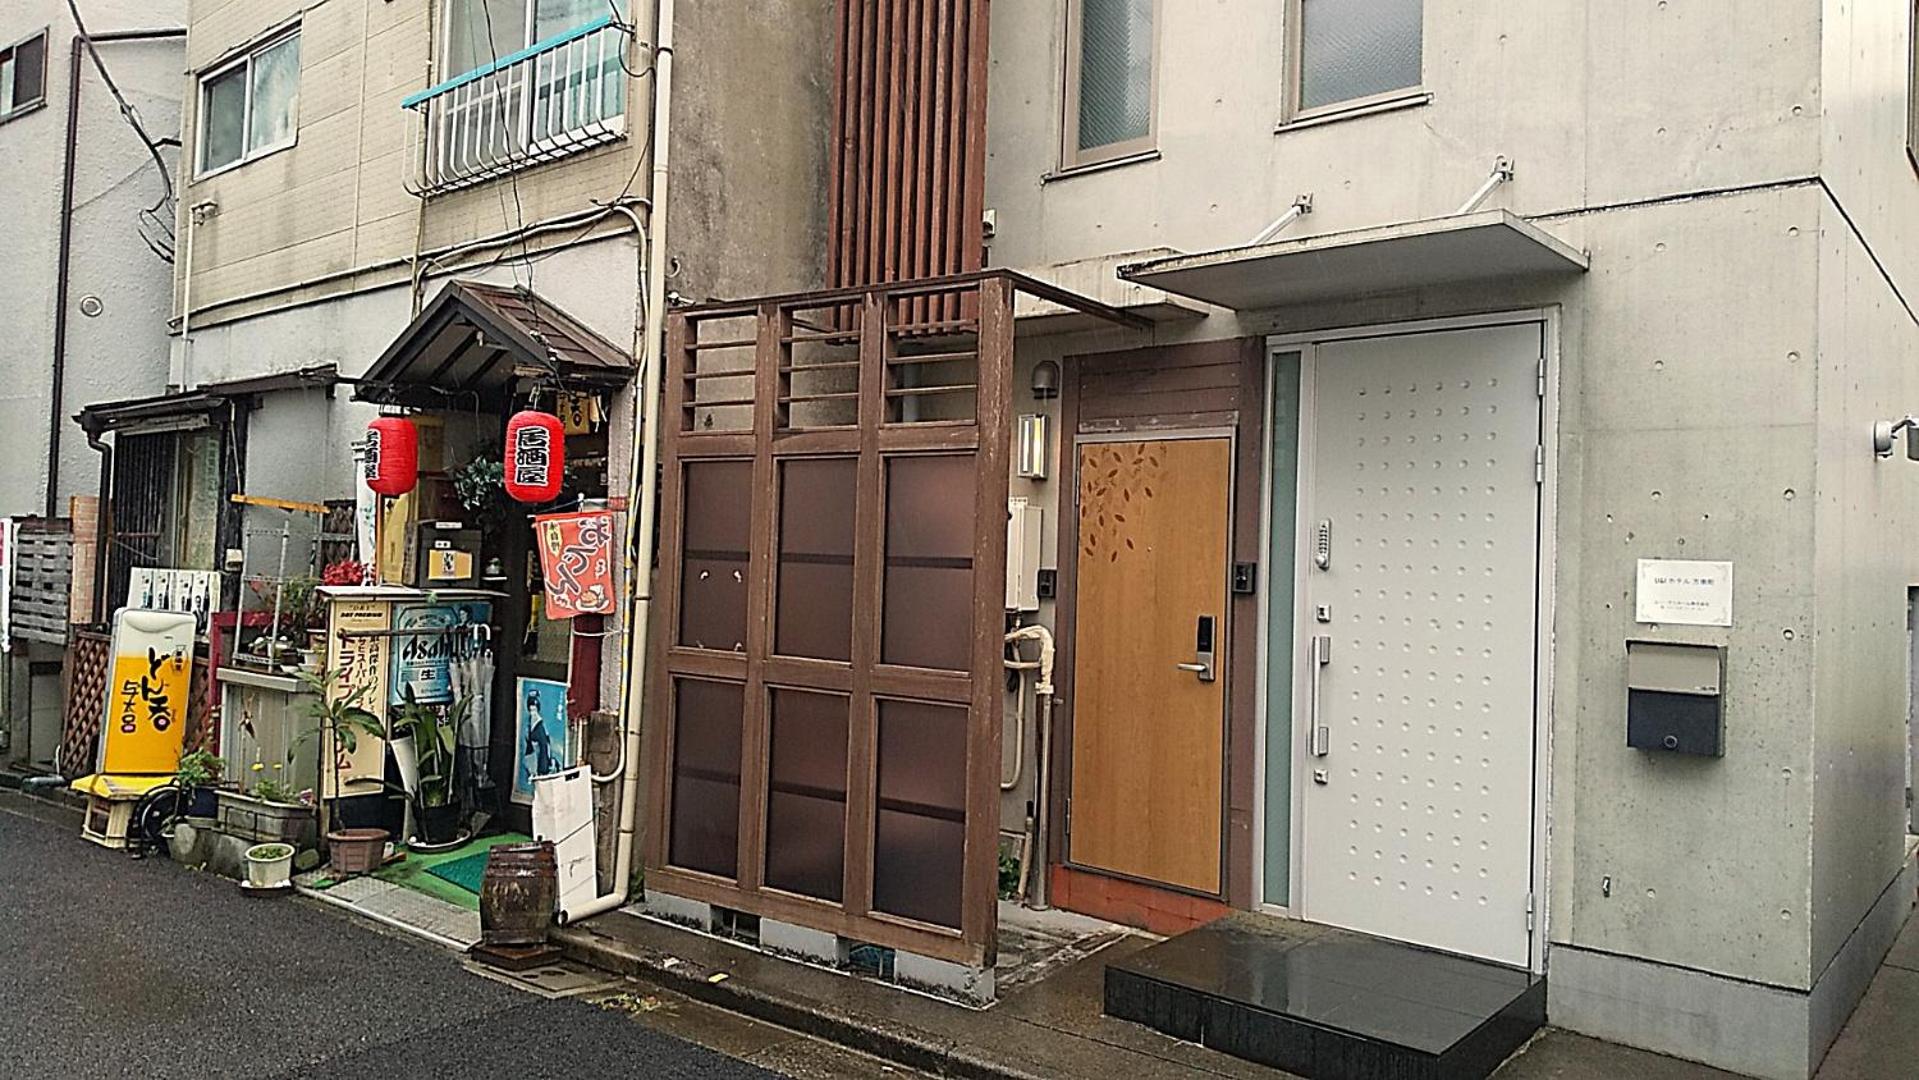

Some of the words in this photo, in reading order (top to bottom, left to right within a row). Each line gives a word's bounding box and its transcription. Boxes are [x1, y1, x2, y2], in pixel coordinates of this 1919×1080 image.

[517, 427, 549, 484] 居酒屋
[545, 517, 610, 596] おでん
[420, 669, 436, 681] 生
